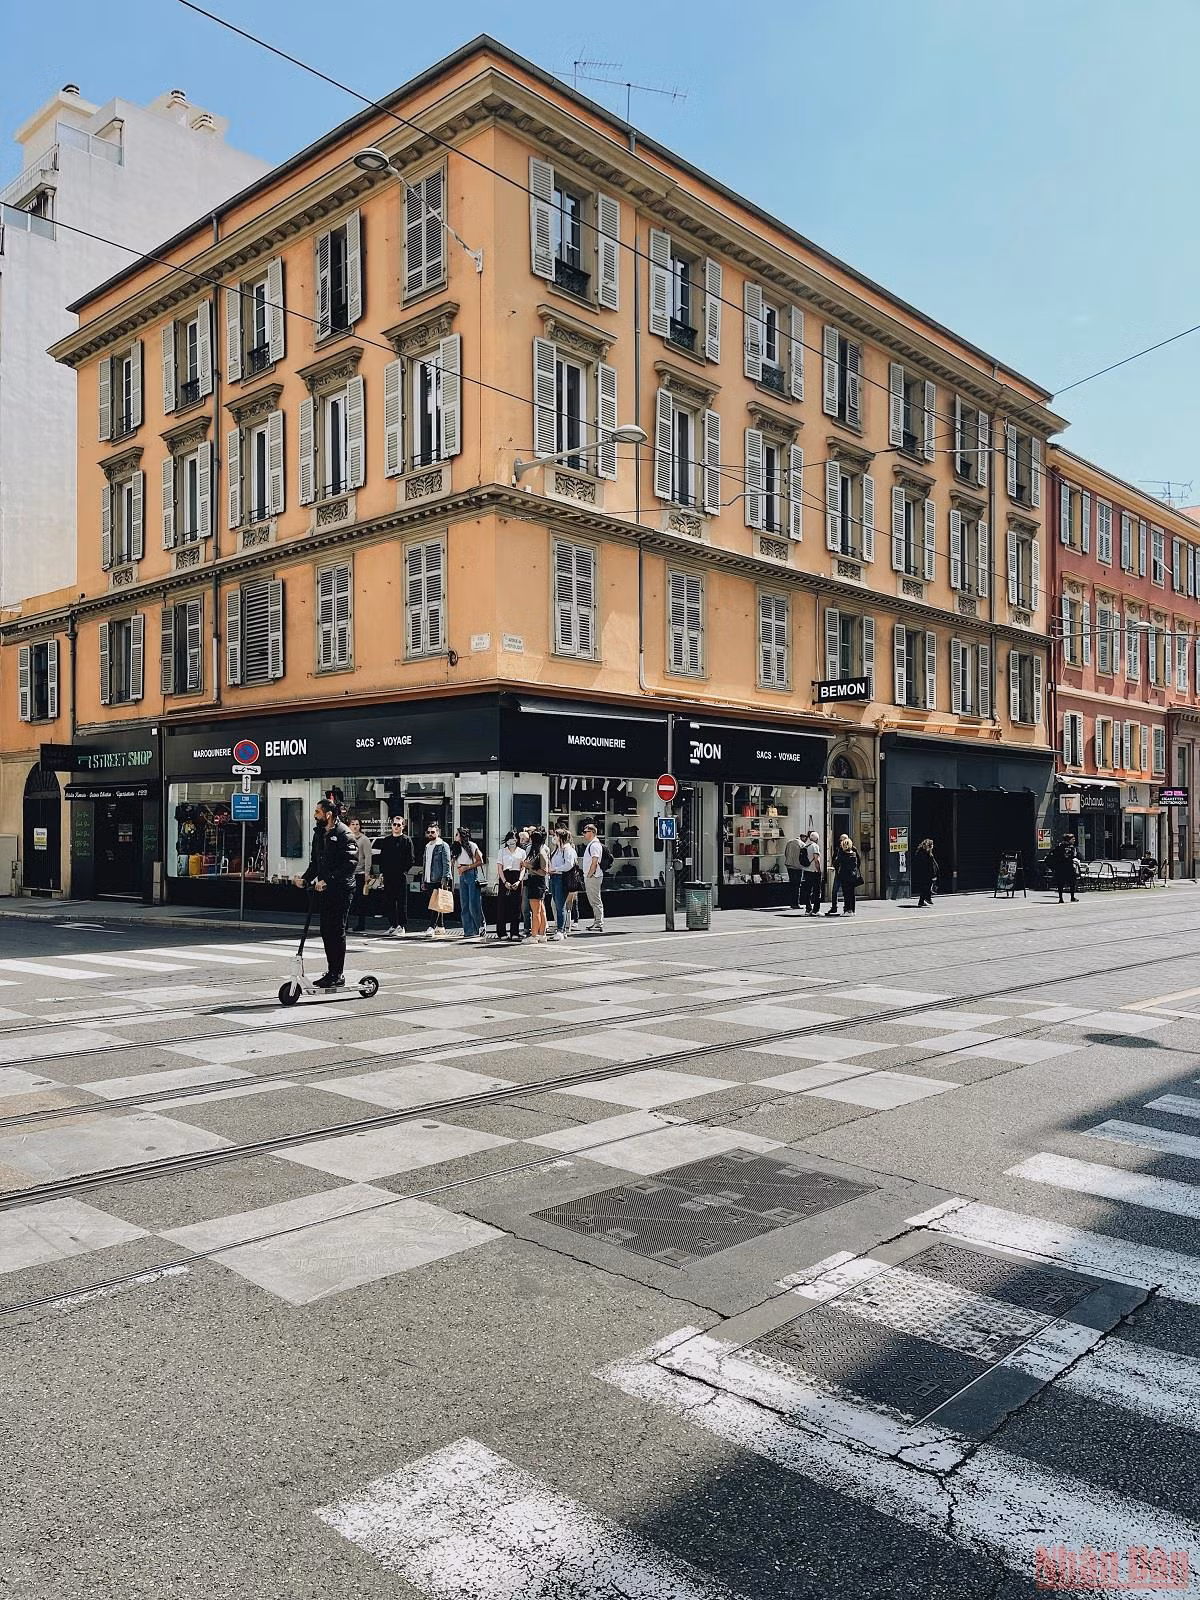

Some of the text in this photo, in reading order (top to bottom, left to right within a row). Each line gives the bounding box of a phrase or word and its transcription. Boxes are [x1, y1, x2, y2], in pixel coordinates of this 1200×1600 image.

[820, 682, 866, 698] BEMON
[265, 739, 307, 757] BEMON
[355, 738, 375, 748] SACS
[383, 735, 412, 746] VOYAGE
[567, 735, 626, 749] MAROQUINERIE
[92, 752, 127, 769] STREET
[127, 750, 153, 766] SHOP
[193, 747, 232, 758] MAROQUINERIE
[756, 750, 772, 760] SACS
[778, 752, 801, 762] VOYAGE
